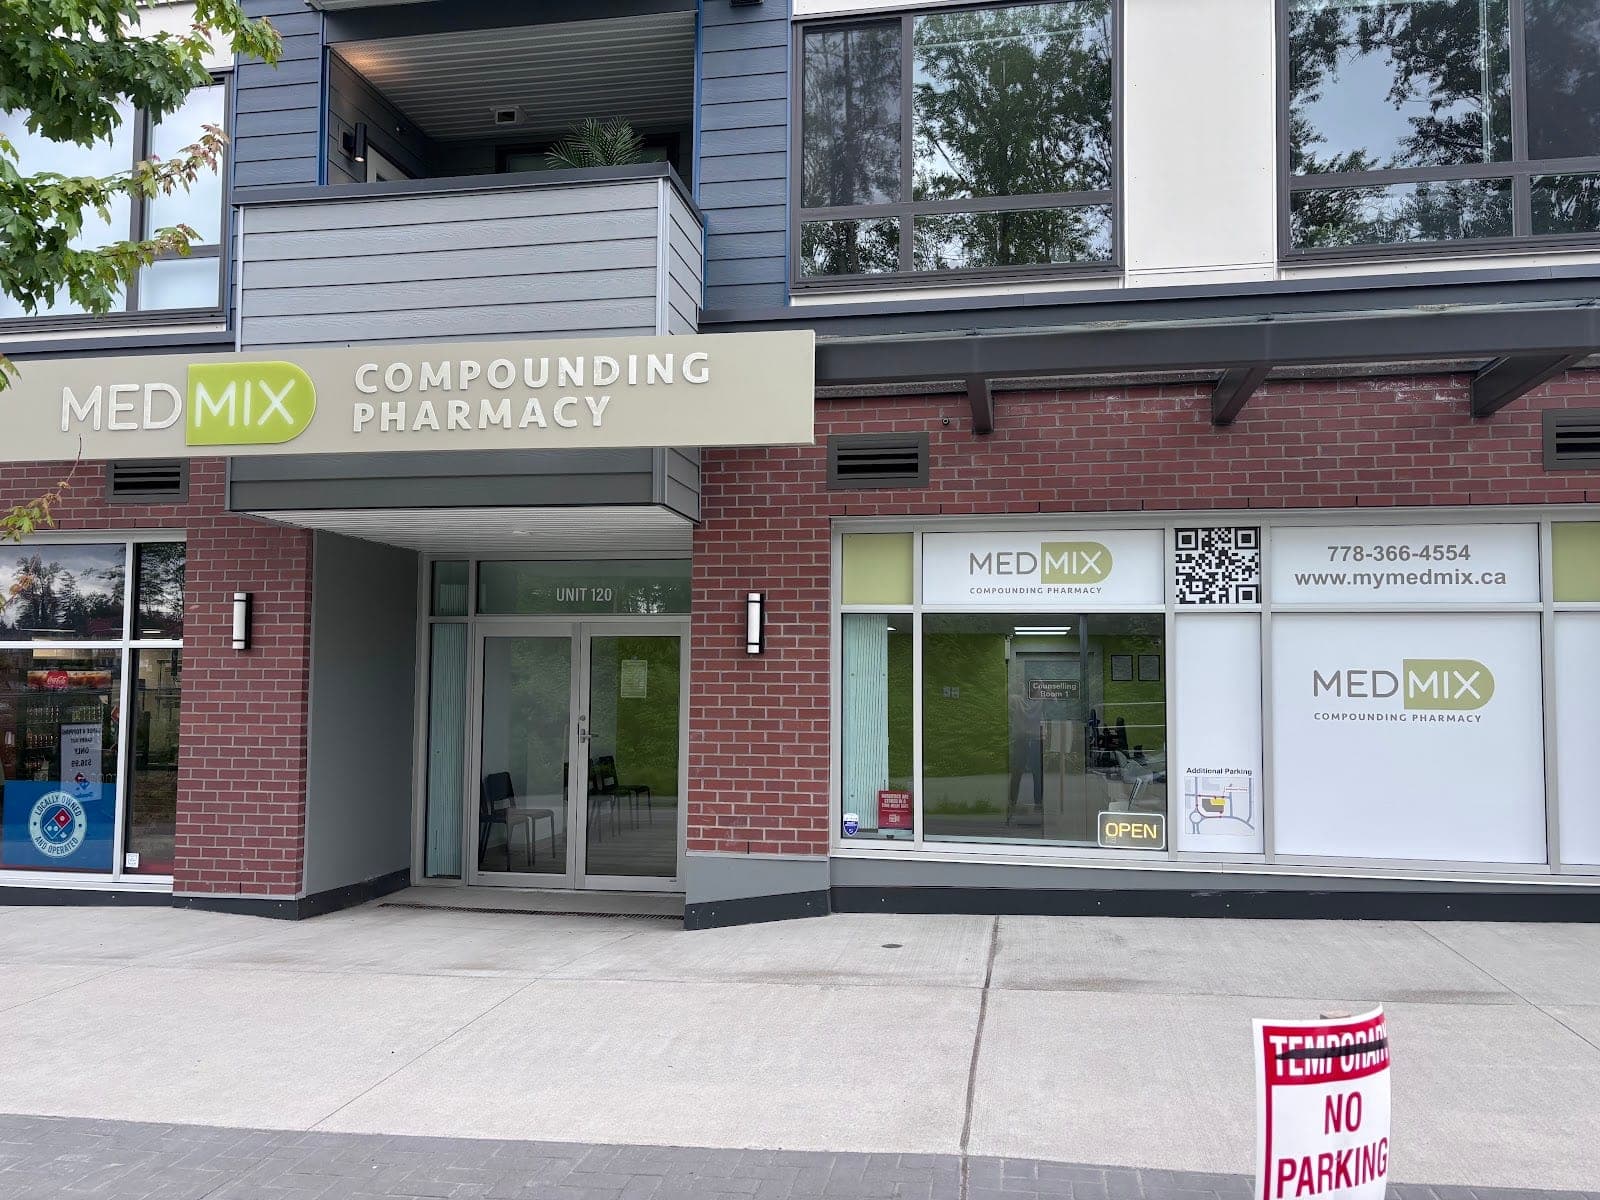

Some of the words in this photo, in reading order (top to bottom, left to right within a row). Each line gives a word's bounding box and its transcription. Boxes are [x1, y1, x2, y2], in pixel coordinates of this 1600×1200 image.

[355, 352, 710, 394] COMPOUNDING
[352, 396, 612, 433] PHARMACY
[1327, 544, 1471, 562] 778-366-4554
[1294, 569, 1507, 589] www.mymedmix.ca
[556, 587, 588, 602] UNIT
[590, 587, 612, 602] 120
[1032, 682, 1077, 690] Counselling
[1314, 712, 1407, 722] COMPOUNDING
[1412, 714, 1481, 723] PHARMACY
[1186, 767, 1223, 775] Additional
[1224, 768, 1253, 776] Parking
[34, 794, 60, 816] LOCALLY
[61, 795, 82, 817] OWNED
[1105, 822, 1157, 839] OPEN
[35, 836, 48, 850] AND
[47, 837, 79, 855] OPERATED
[1324, 1091, 1362, 1135] NO
[1276, 1137, 1388, 1200] PARKING
